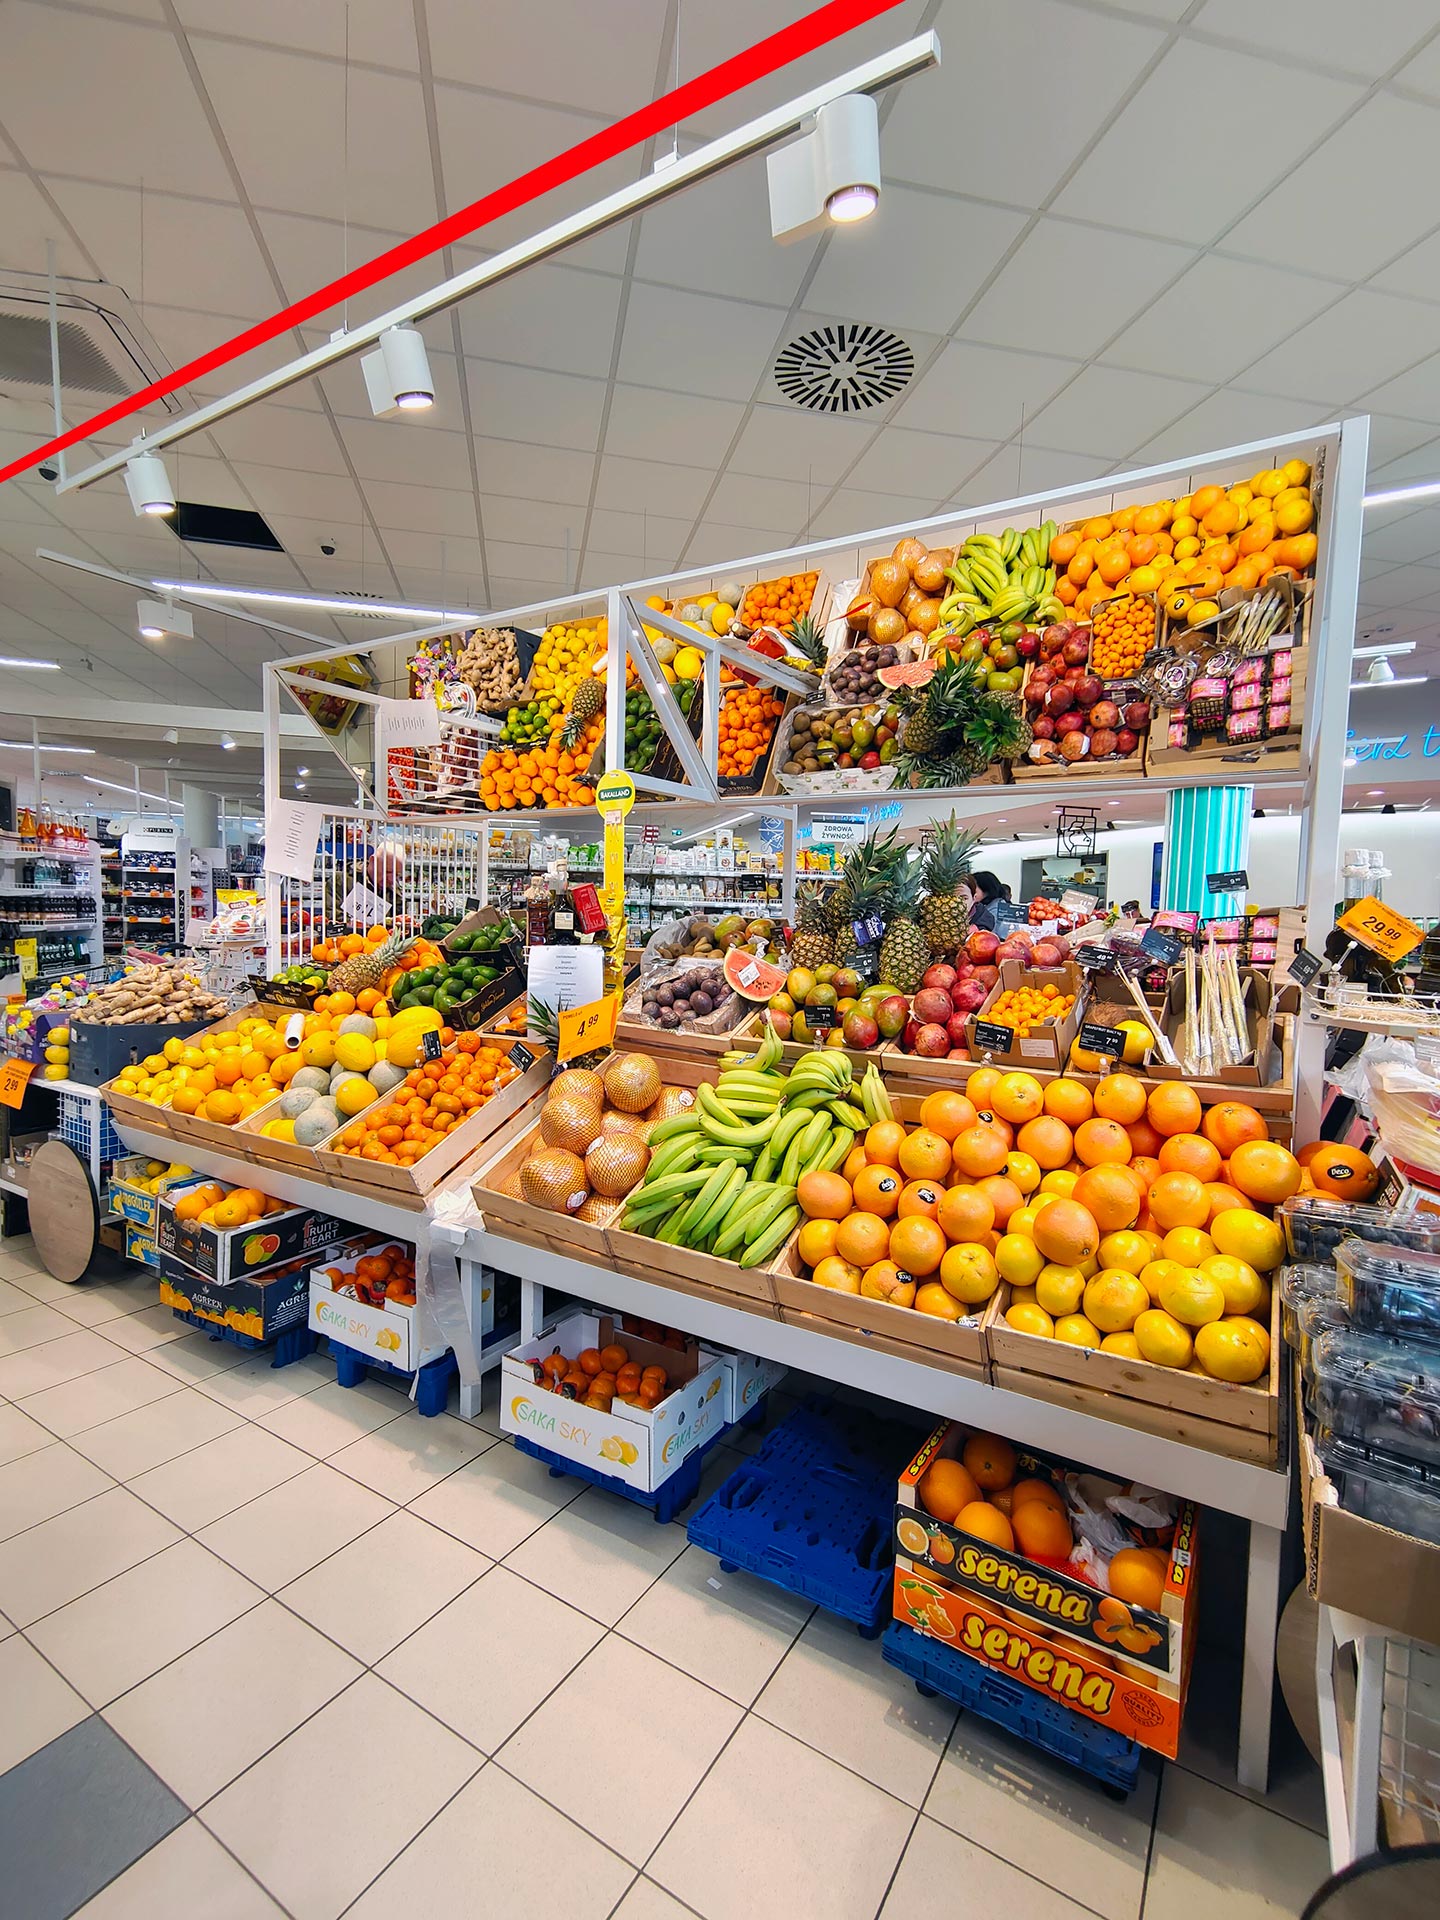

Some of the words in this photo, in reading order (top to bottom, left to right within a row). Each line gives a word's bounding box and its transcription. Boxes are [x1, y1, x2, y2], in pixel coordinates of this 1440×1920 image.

[600, 788, 630, 800] BAKALLAND
[821, 831, 855, 840] ŻYWNOŚĆ
[823, 825, 853, 833] ZDROWA
[1330, 1168, 1350, 1176] Deco
[191, 1292, 223, 1309] AGREEN
[277, 1292, 310, 1311] AGRE
[321, 1307, 347, 1330] SAKA
[347, 1319, 371, 1338] SKY
[518, 1403, 556, 1433] SAKA
[559, 1421, 592, 1446] SKY
[667, 1425, 692, 1457] SAKA
[958, 1546, 1090, 1622] serena
[963, 1615, 1114, 1712] serena
[1123, 1694, 1162, 1721] QUALITY
